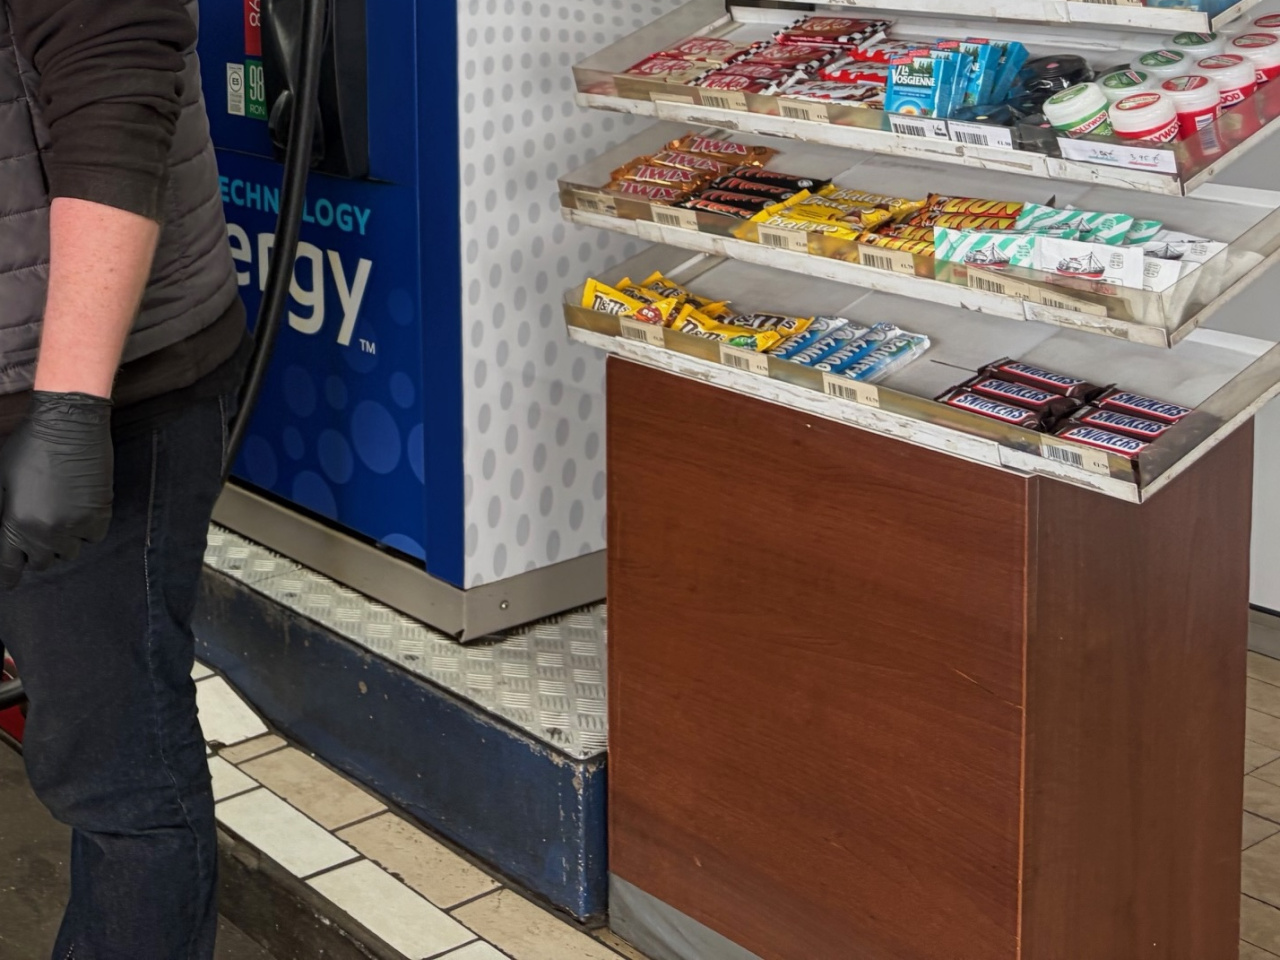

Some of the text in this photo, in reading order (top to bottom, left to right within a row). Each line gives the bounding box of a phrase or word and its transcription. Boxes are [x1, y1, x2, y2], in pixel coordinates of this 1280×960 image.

[250, 65, 265, 101] 98
[901, 67, 909, 76] LA
[250, 104, 265, 115] RON
[691, 136, 748, 155] TWIX
[637, 166, 695, 183] TWIX
[620, 181, 678, 200] TWIX
[218, 176, 371, 235] ECHNLOGY
[942, 198, 1023, 215] LION
[935, 214, 1016, 230] LION
[227, 223, 375, 354] ergy TM
[815, 336, 867, 371] OUNTY
[1010, 363, 1084, 386] SNICKERS
[982, 379, 1056, 402] SNICKERS
[956, 394, 1028, 420] SNICKERS
[1112, 392, 1190, 417] SNICKERS
[1092, 410, 1166, 433] SNICKERS
[1070, 427, 1144, 451] SNICKERS
